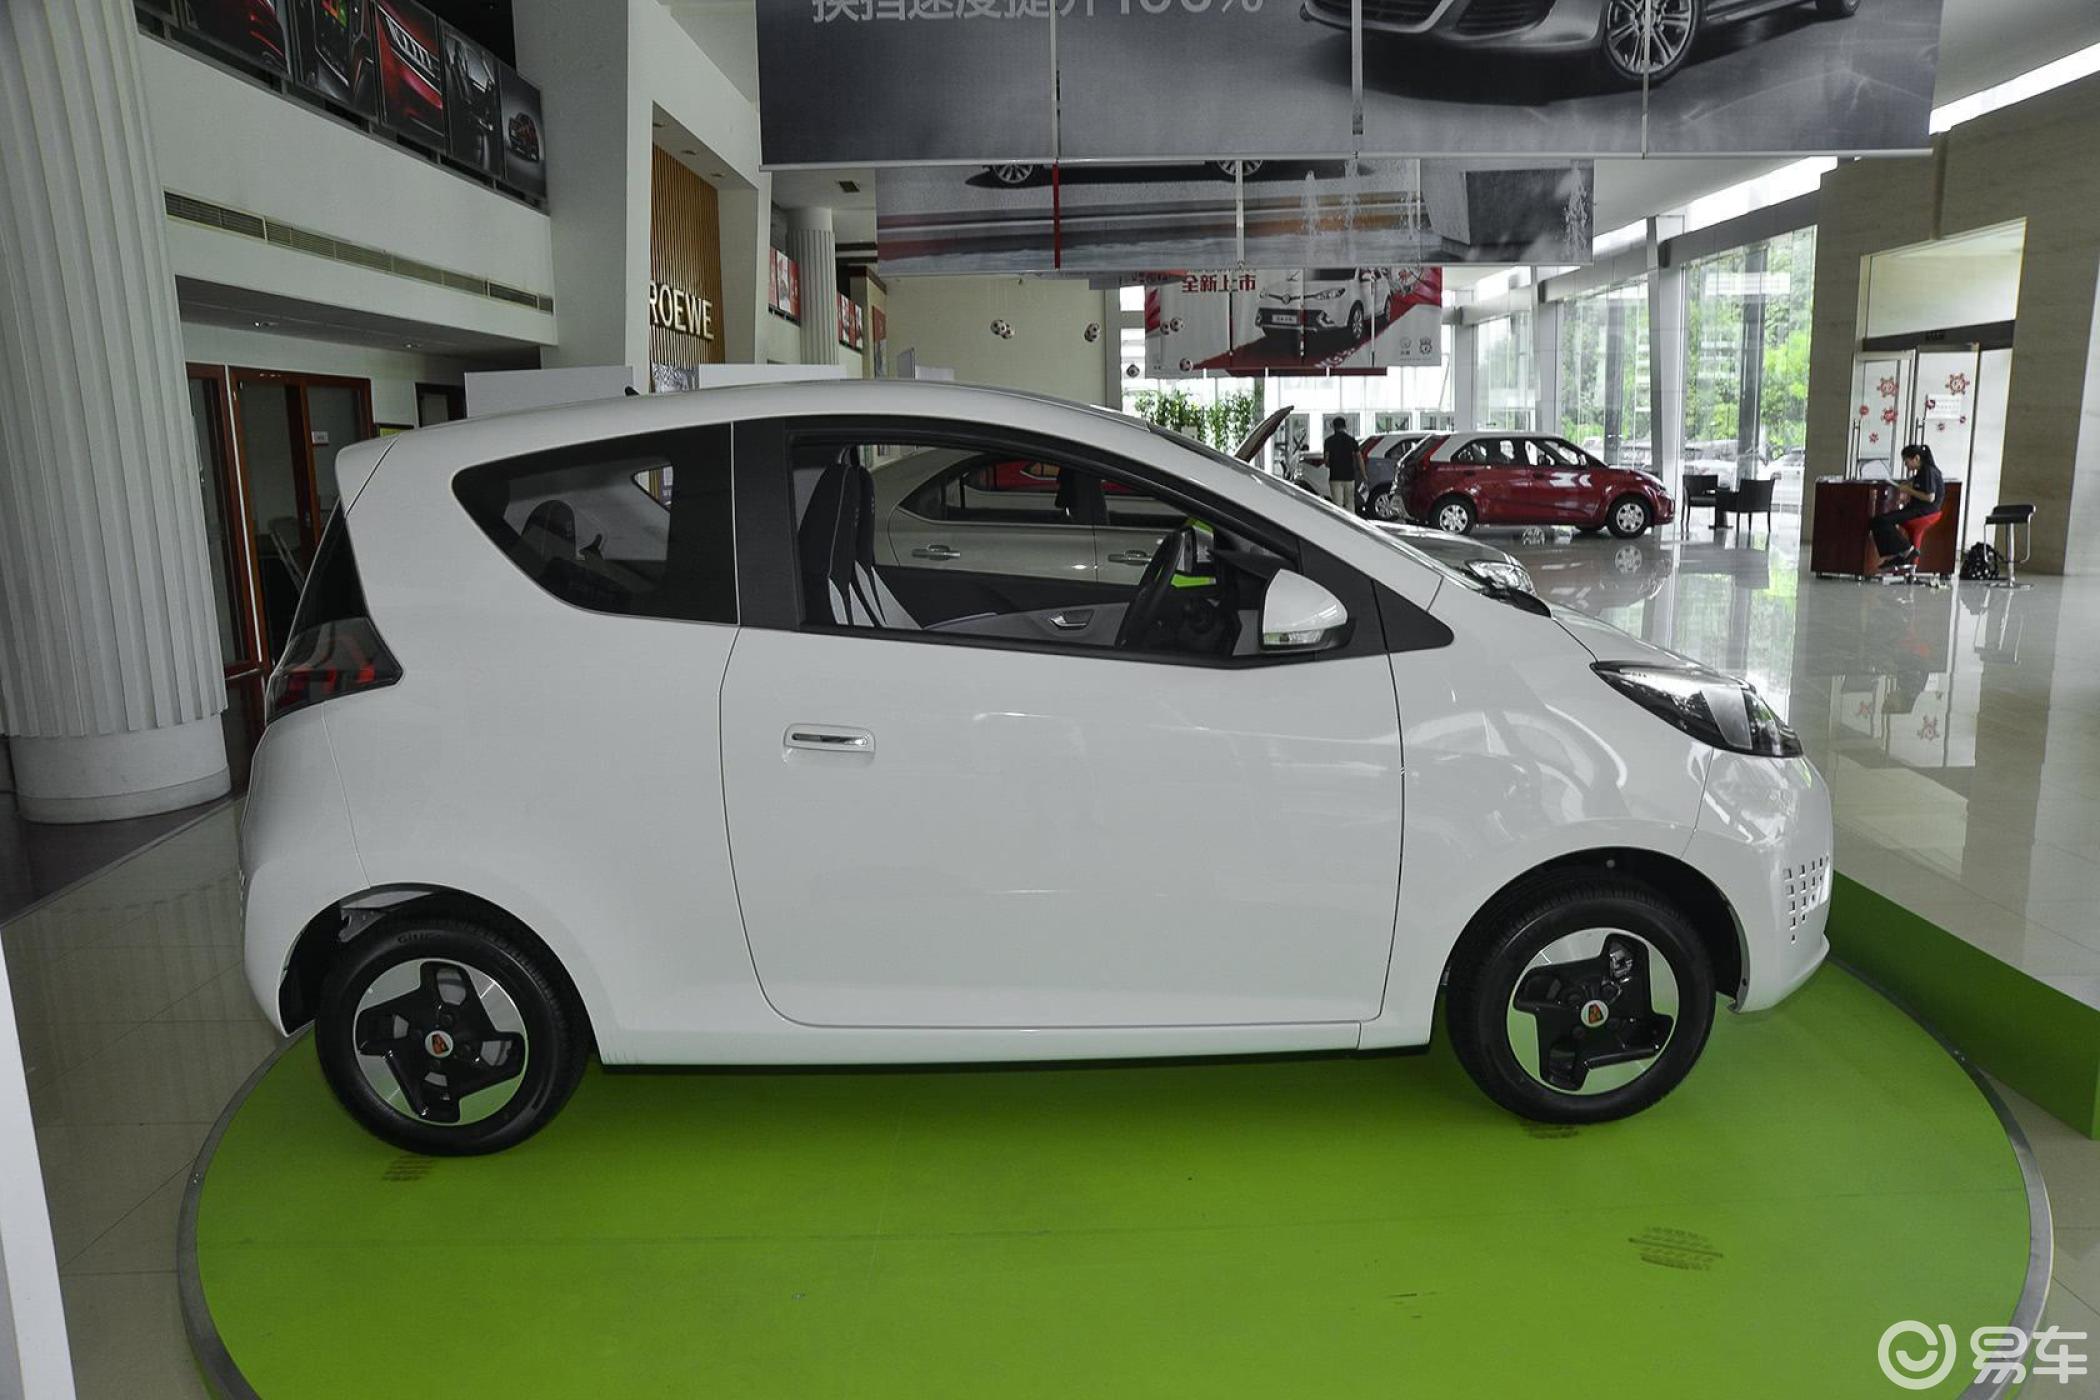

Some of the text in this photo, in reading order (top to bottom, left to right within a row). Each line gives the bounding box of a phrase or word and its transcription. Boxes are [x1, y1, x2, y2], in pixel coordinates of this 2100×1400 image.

[1182, 274, 1257, 293] 全新上市
[650, 281, 714, 340] ROEWE
